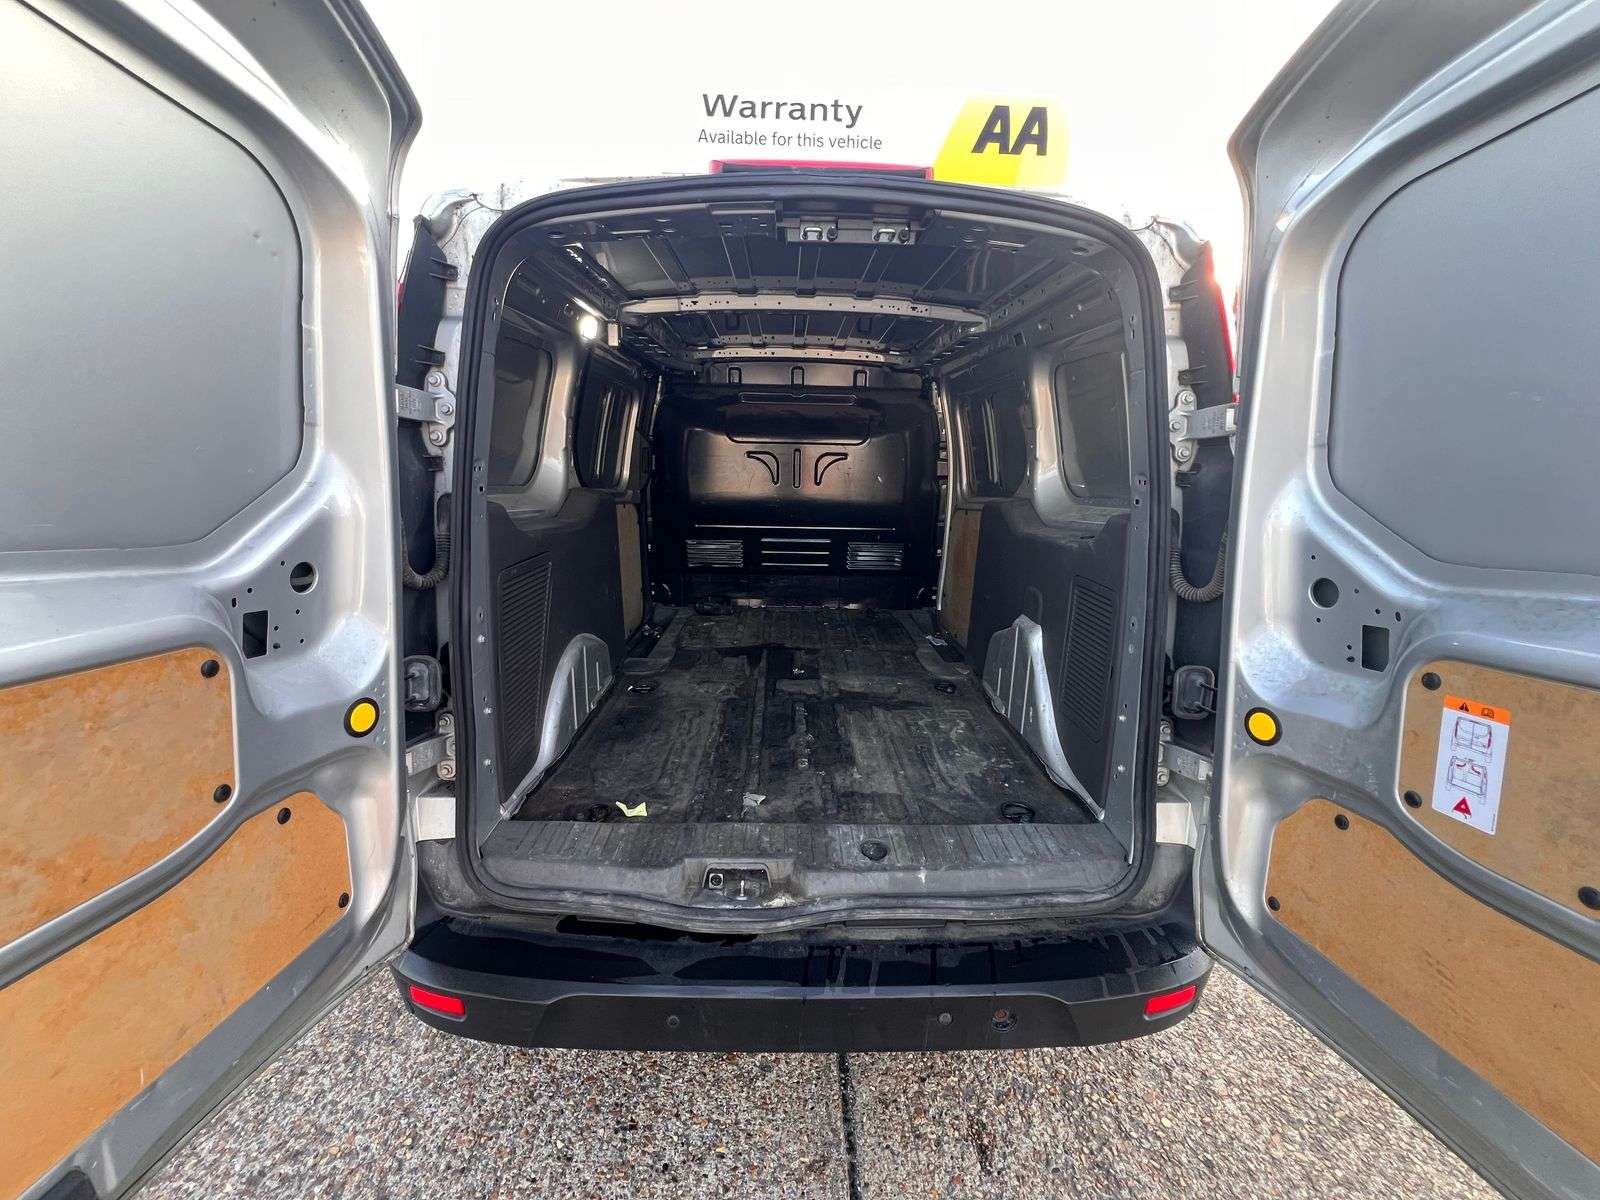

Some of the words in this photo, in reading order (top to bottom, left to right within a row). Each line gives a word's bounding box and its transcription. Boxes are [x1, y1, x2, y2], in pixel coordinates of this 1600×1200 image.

[702, 93, 863, 128] Warranty
[698, 129, 767, 146] Available
[771, 131, 793, 147] for
[797, 132, 825, 148] this
[828, 135, 883, 150] vehicle
[971, 105, 1048, 156] AA
